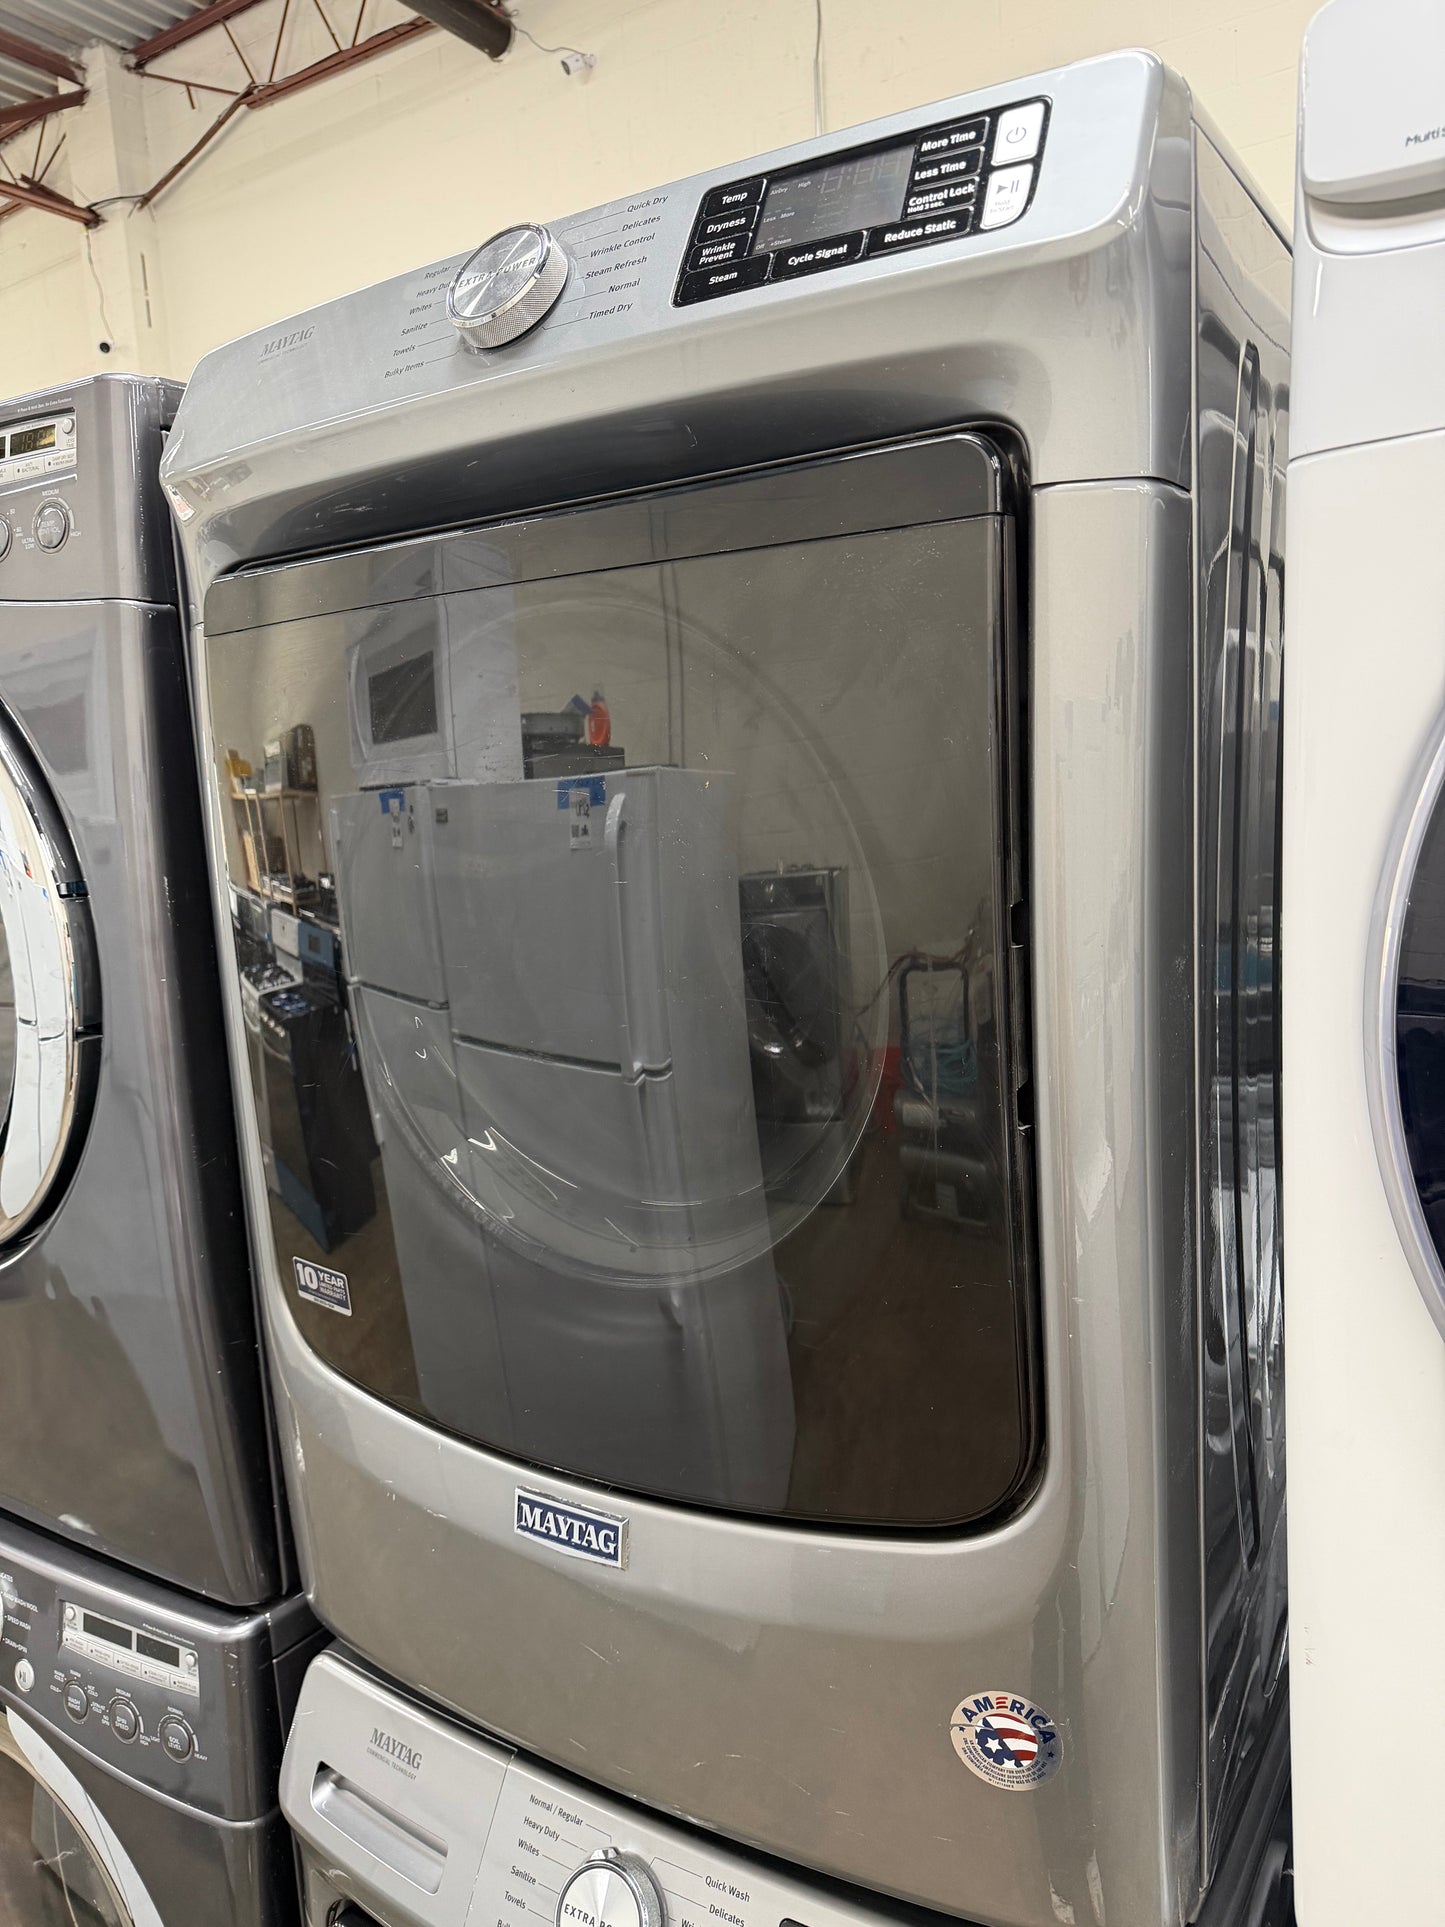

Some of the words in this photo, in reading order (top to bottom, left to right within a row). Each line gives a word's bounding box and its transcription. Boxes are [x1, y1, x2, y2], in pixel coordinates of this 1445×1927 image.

[921, 138, 949, 152] More
[949, 131, 976, 142] Time
[914, 167, 939, 180] Less
[940, 161, 967, 173] Time
[627, 200, 651, 213] Quick
[652, 195, 669, 205] Dry
[722, 192, 748, 205] Temp
[908, 189, 949, 206] Control
[949, 183, 975, 197] Lock
[907, 205, 924, 214] Hold
[621, 215, 661, 232] Delicates
[706, 217, 747, 234] Dryness
[884, 228, 924, 243] Reduce
[924, 219, 956, 234] Static
[590, 243, 622, 258] Wrinkle
[623, 232, 656, 248] Control
[702, 242, 736, 256] Wrinkle
[787, 253, 814, 266] Cycle
[815, 244, 848, 260] Signal
[584, 266, 613, 280] Steam
[613, 255, 648, 271] Refresh
[699, 250, 734, 265] Prevent
[424, 266, 451, 280] Regular
[458, 271, 493, 288] EXTRA
[495, 257, 536, 277] POWER
[708, 272, 738, 285] Steam
[416, 285, 438, 298] Heavy
[608, 278, 641, 293] Normal
[409, 303, 433, 316] Whites
[588, 306, 616, 320] Timed
[616, 302, 634, 313] Dry
[401, 322, 429, 337] Sanitize
[259, 325, 316, 358] MAYTAG
[393, 344, 417, 357] Towels
[384, 366, 404, 379] Bulky
[296, 1262, 319, 1290] 10
[317, 1270, 345, 1289] YEAR
[520, 1502, 617, 1556] MAYTAG
[961, 1695, 1057, 1745] AMERICA
[370, 1727, 423, 1770] MAYTAG
[529, 1794, 553, 1813] Normal
[552, 1804, 558, 1815] /
[558, 1808, 584, 1827] Regular
[523, 1815, 544, 1835] Heavy
[543, 1825, 561, 1842] Duty
[518, 1838, 541, 1857] Whites
[510, 1865, 537, 1886] Sanitize
[705, 1875, 728, 1893] Quick
[727, 1884, 750, 1903] Wash
[505, 1890, 527, 1910] Towels
[564, 1903, 596, 1927] EXTRA
[708, 1903, 745, 1927] Delicates
